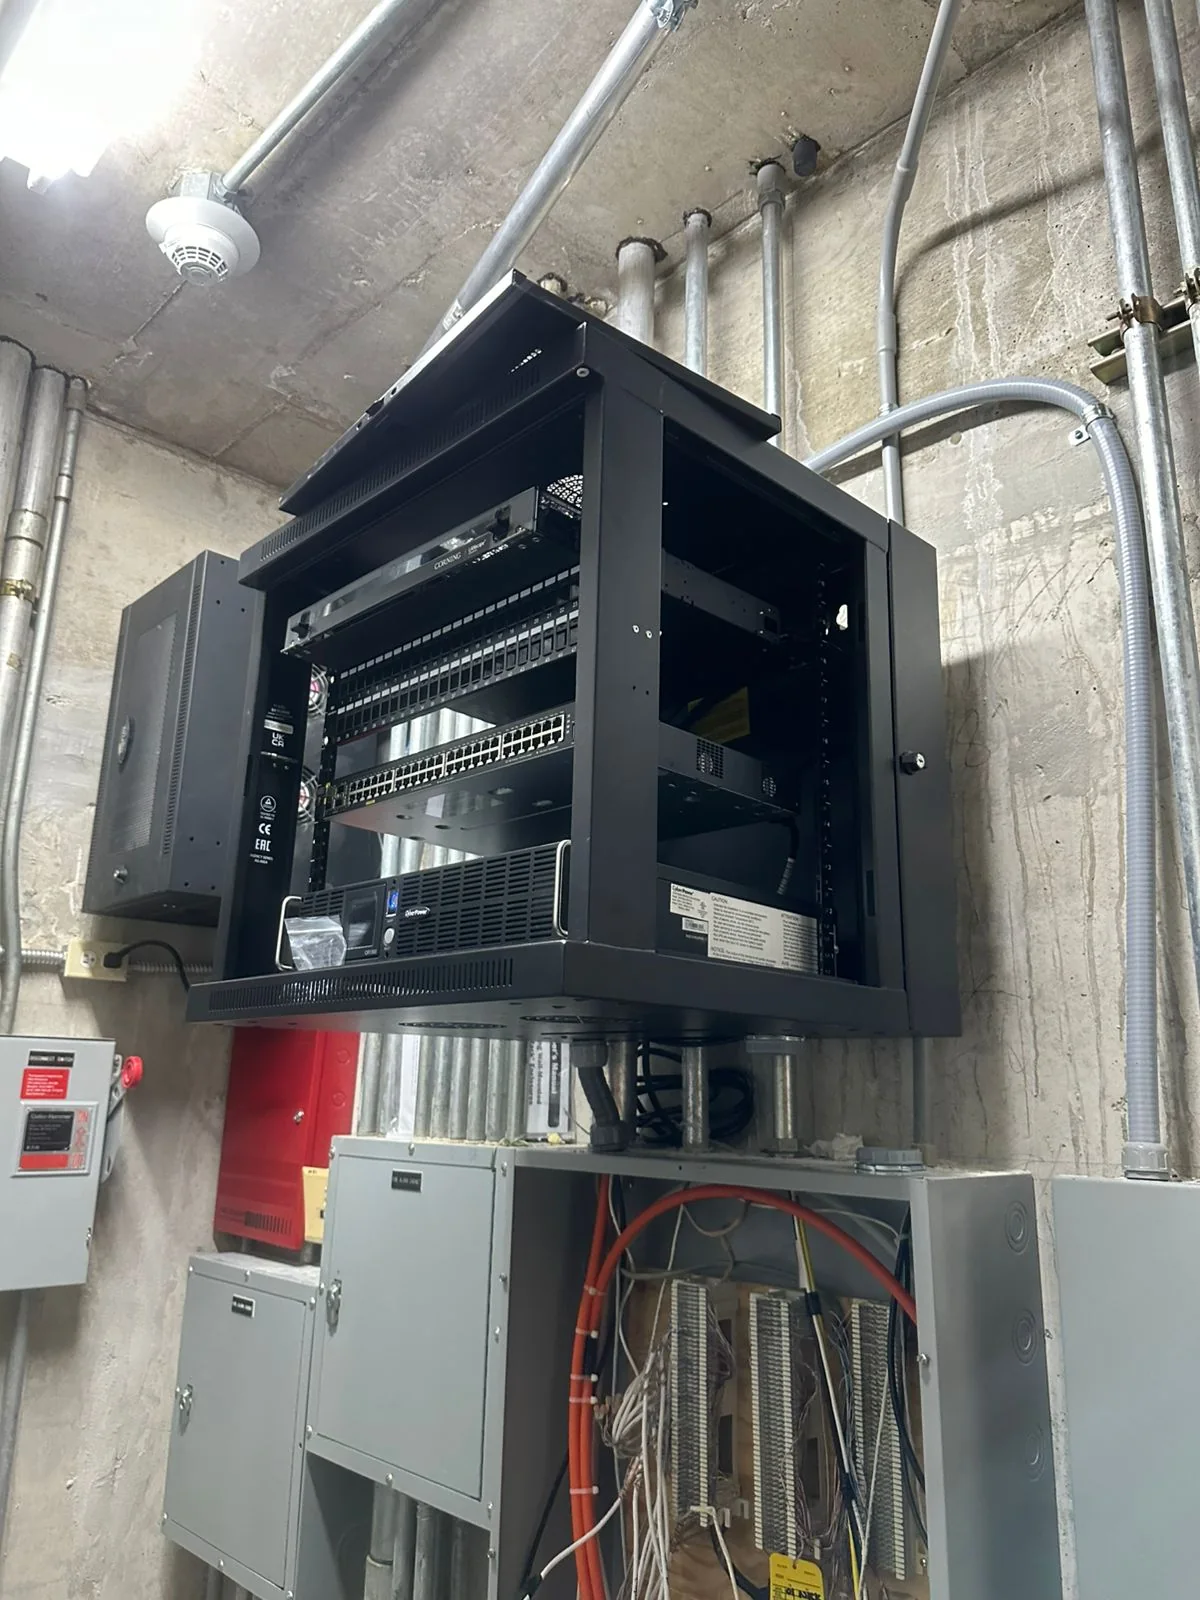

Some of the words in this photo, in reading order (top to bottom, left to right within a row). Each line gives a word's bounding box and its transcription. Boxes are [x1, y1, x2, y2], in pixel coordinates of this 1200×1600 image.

[434, 551, 462, 570] CORNING
[271, 738, 285, 748] CA
[272, 732, 285, 741] UK
[258, 823, 272, 836] CE
[255, 838, 272, 852] EAC
[551, 1062, 559, 1094] Manual
